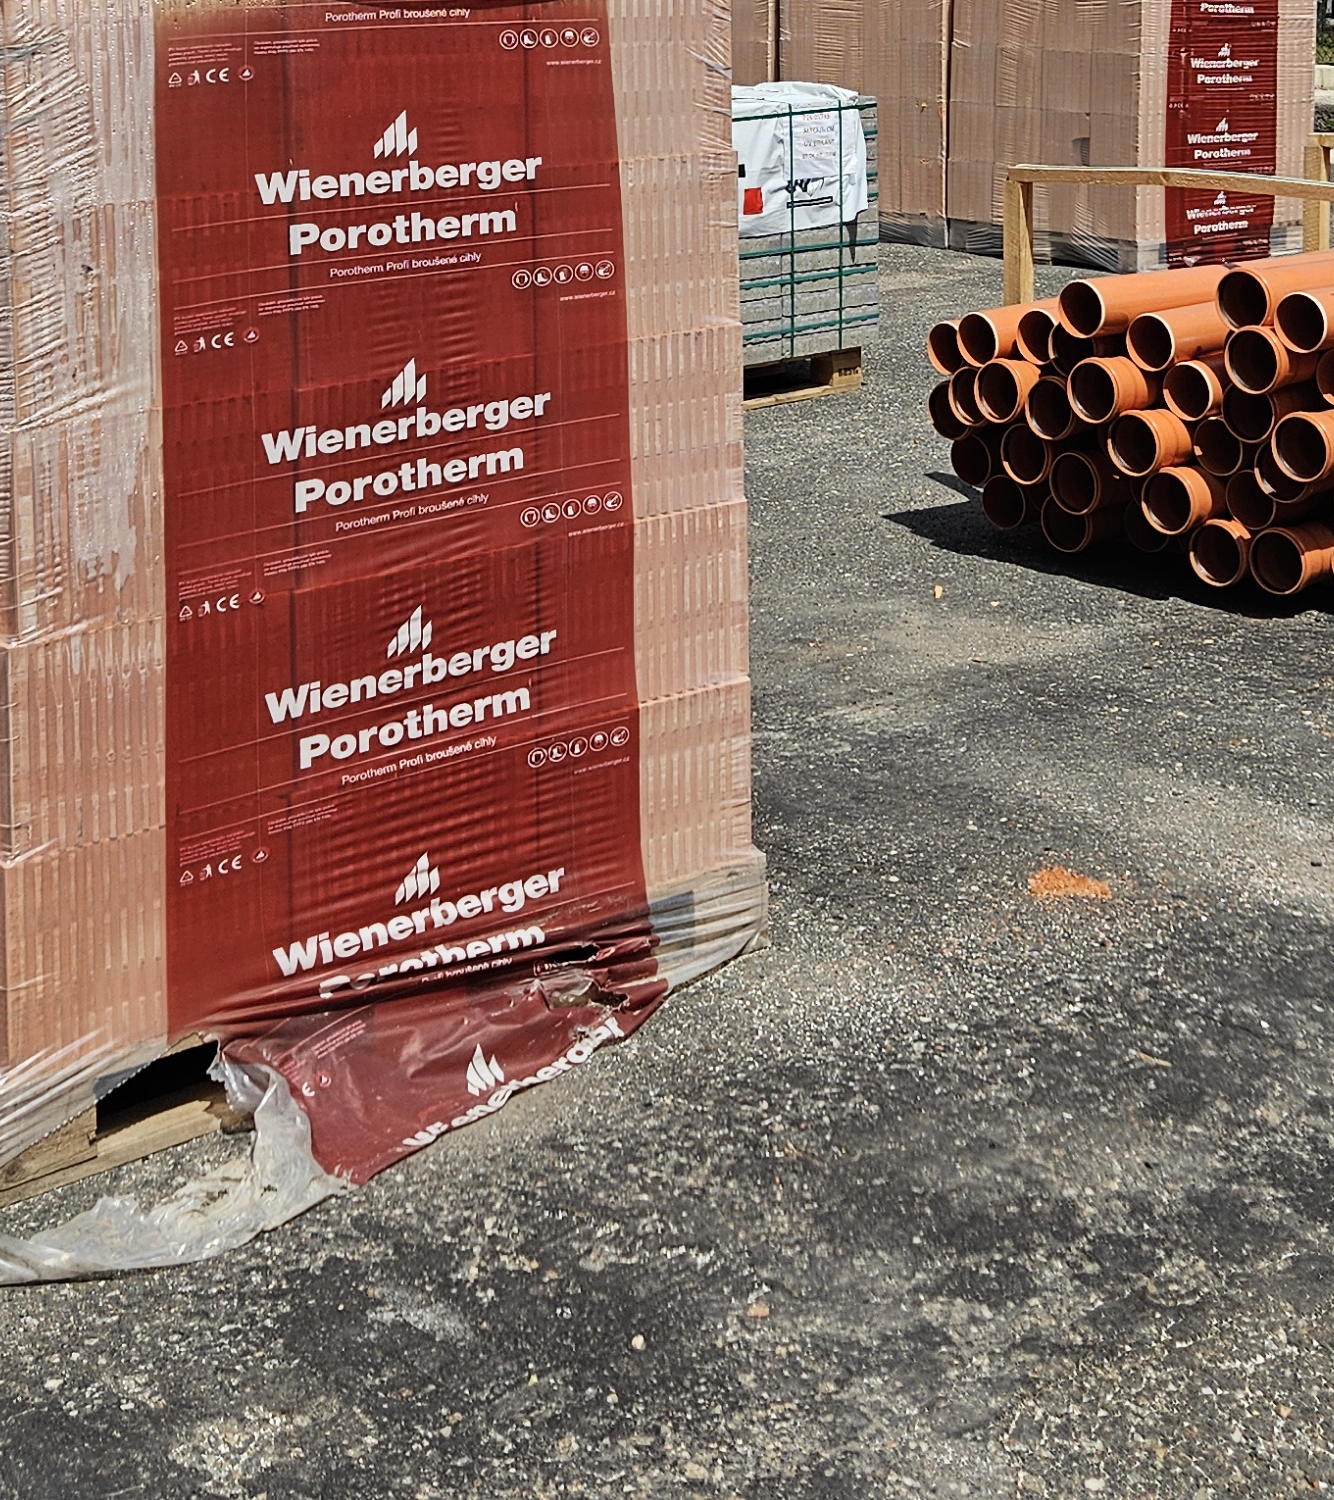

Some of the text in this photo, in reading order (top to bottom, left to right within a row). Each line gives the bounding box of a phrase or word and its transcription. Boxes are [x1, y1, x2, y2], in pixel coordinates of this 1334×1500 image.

[325, 11, 376, 23] Porotherm
[379, 9, 401, 20] Profi
[449, 7, 471, 19] cihly
[1190, 58, 1259, 70] Wienerberger
[1197, 74, 1253, 84] Porotherm
[1187, 132, 1258, 144] Wienerberger
[1194, 148, 1251, 159] Porotherm
[254, 155, 542, 205] Wienerberger
[289, 206, 516, 255] Porotherm
[1194, 221, 1249, 234] Porotherm
[329, 264, 384, 277] Porotherm
[386, 260, 409, 272] Profi
[459, 252, 482, 264] cihly
[261, 391, 551, 465] Wienerberger
[295, 447, 524, 513] Porotherm
[335, 514, 390, 531] Porotherm
[392, 508, 416, 520] Profi
[466, 493, 490, 507] cihly
[265, 629, 557, 725] Wienerberger
[299, 686, 530, 769] Porotherm
[341, 763, 397, 785] Porotherm
[399, 755, 423, 770] Profi
[474, 736, 497, 750] cihly
[272, 867, 565, 978] Wienerberger
